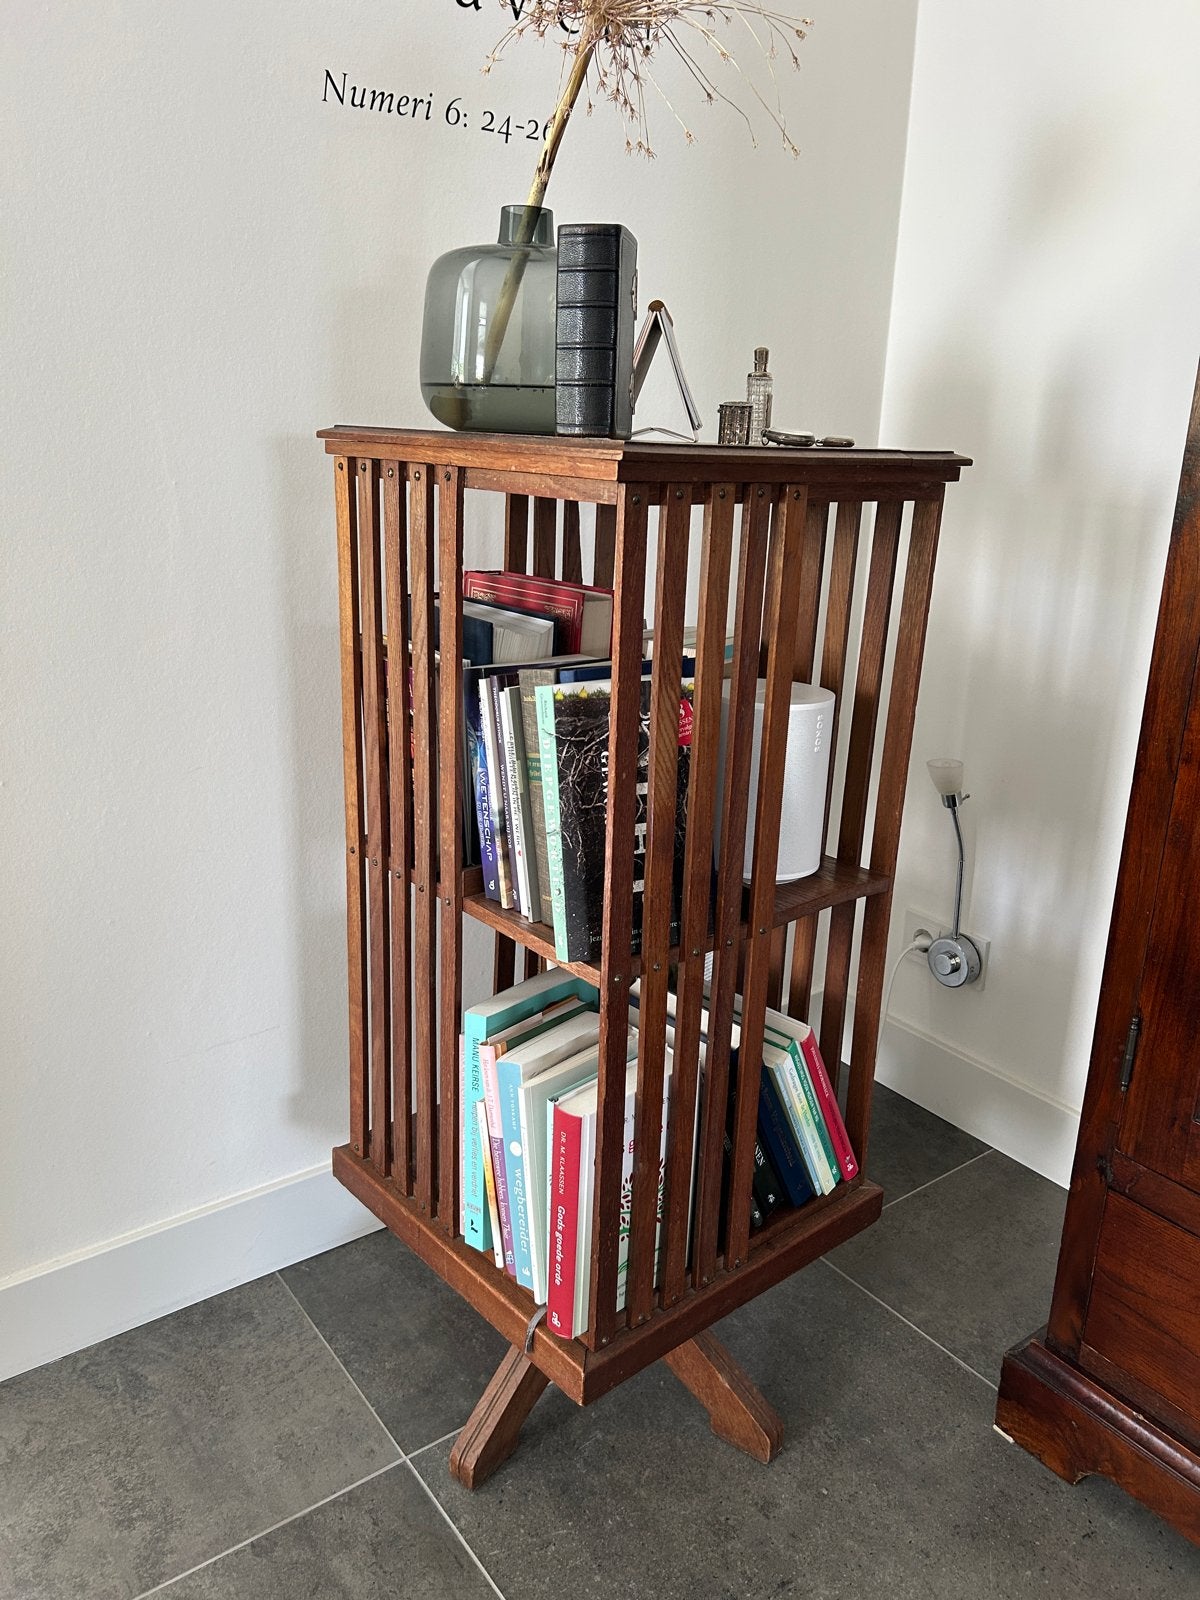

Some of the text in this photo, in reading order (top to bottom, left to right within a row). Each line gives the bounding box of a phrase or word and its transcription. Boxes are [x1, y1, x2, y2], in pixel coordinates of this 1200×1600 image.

[322, 68, 434, 121] Numeri
[445, 97, 469, 128] 6:
[479, 771, 493, 862] WETENSCHAP
[471, 1037, 480, 1093] MANU KEIRSE
[471, 1172, 479, 1197] verdriet
[558, 1156, 567, 1195] KLAASSEN
[513, 1168, 530, 1256] wegbereider
[554, 1205, 566, 1286] Gods goede orde
